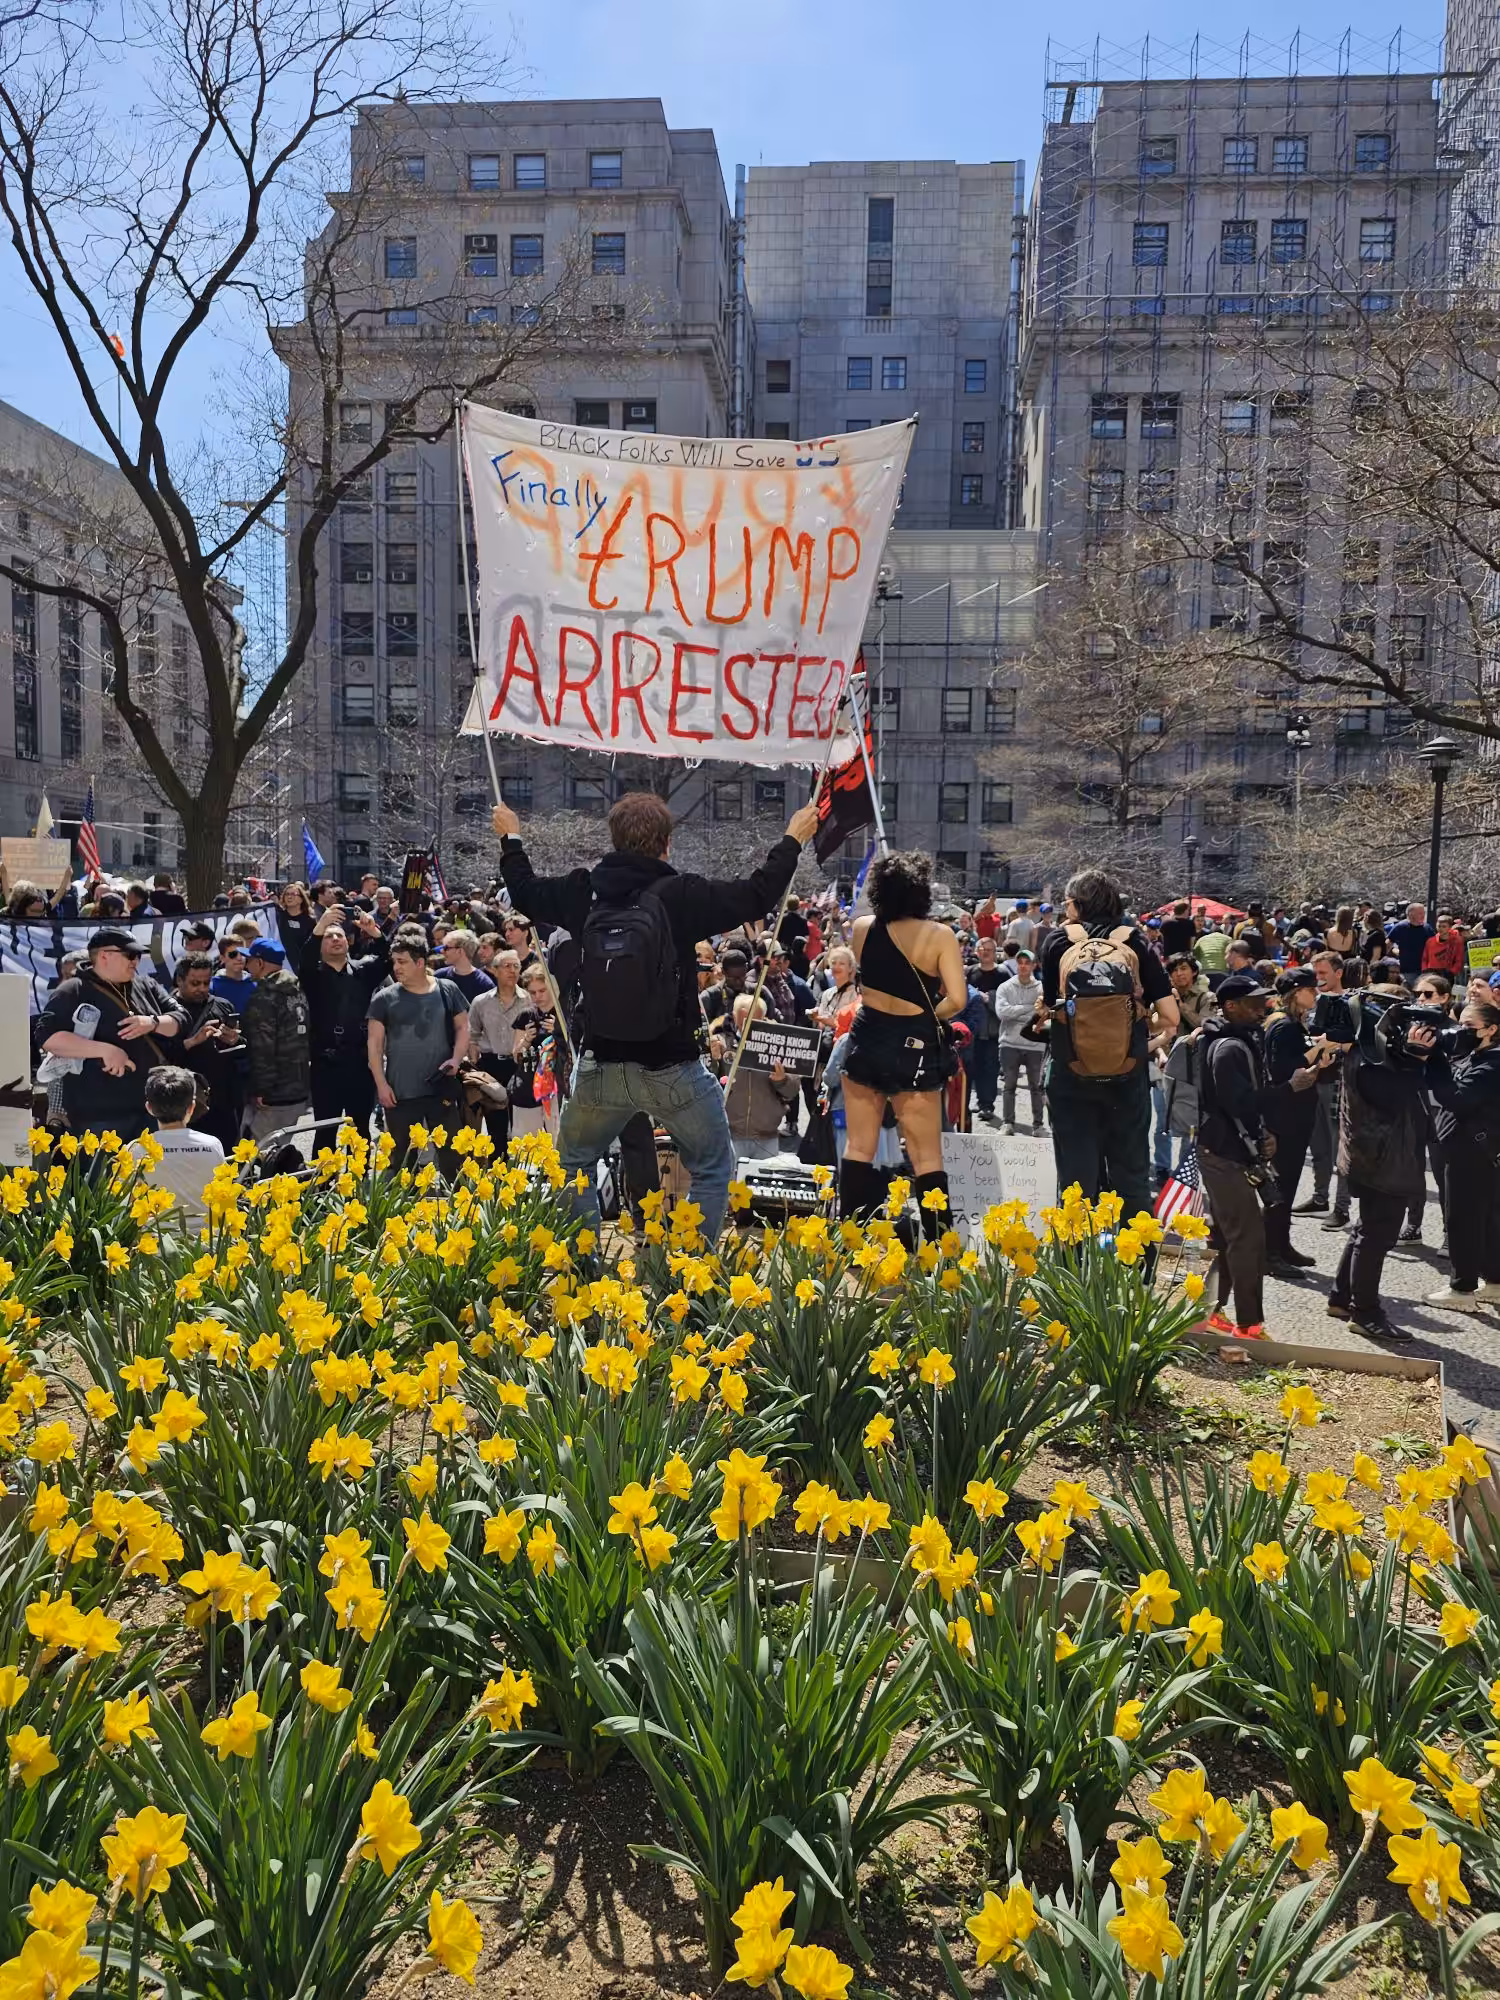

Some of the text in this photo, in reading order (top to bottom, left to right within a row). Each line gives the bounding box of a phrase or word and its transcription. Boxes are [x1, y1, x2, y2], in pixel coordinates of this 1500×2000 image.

[540, 424, 610, 460] BLACK
[680, 441, 724, 467] Will
[733, 445, 786, 468] Save
[491, 449, 607, 540] Finally
[488, 614, 844, 743] ARRESTED
[751, 1030, 811, 1049] WITCHES KNOW
[745, 1040, 818, 1060] RUMP IS A DANGER
[758, 1053, 797, 1069] TO US ALL
[1003, 1155, 1036, 1167] would
[947, 1174, 965, 1185] ave
[975, 1172, 1000, 1186] been
